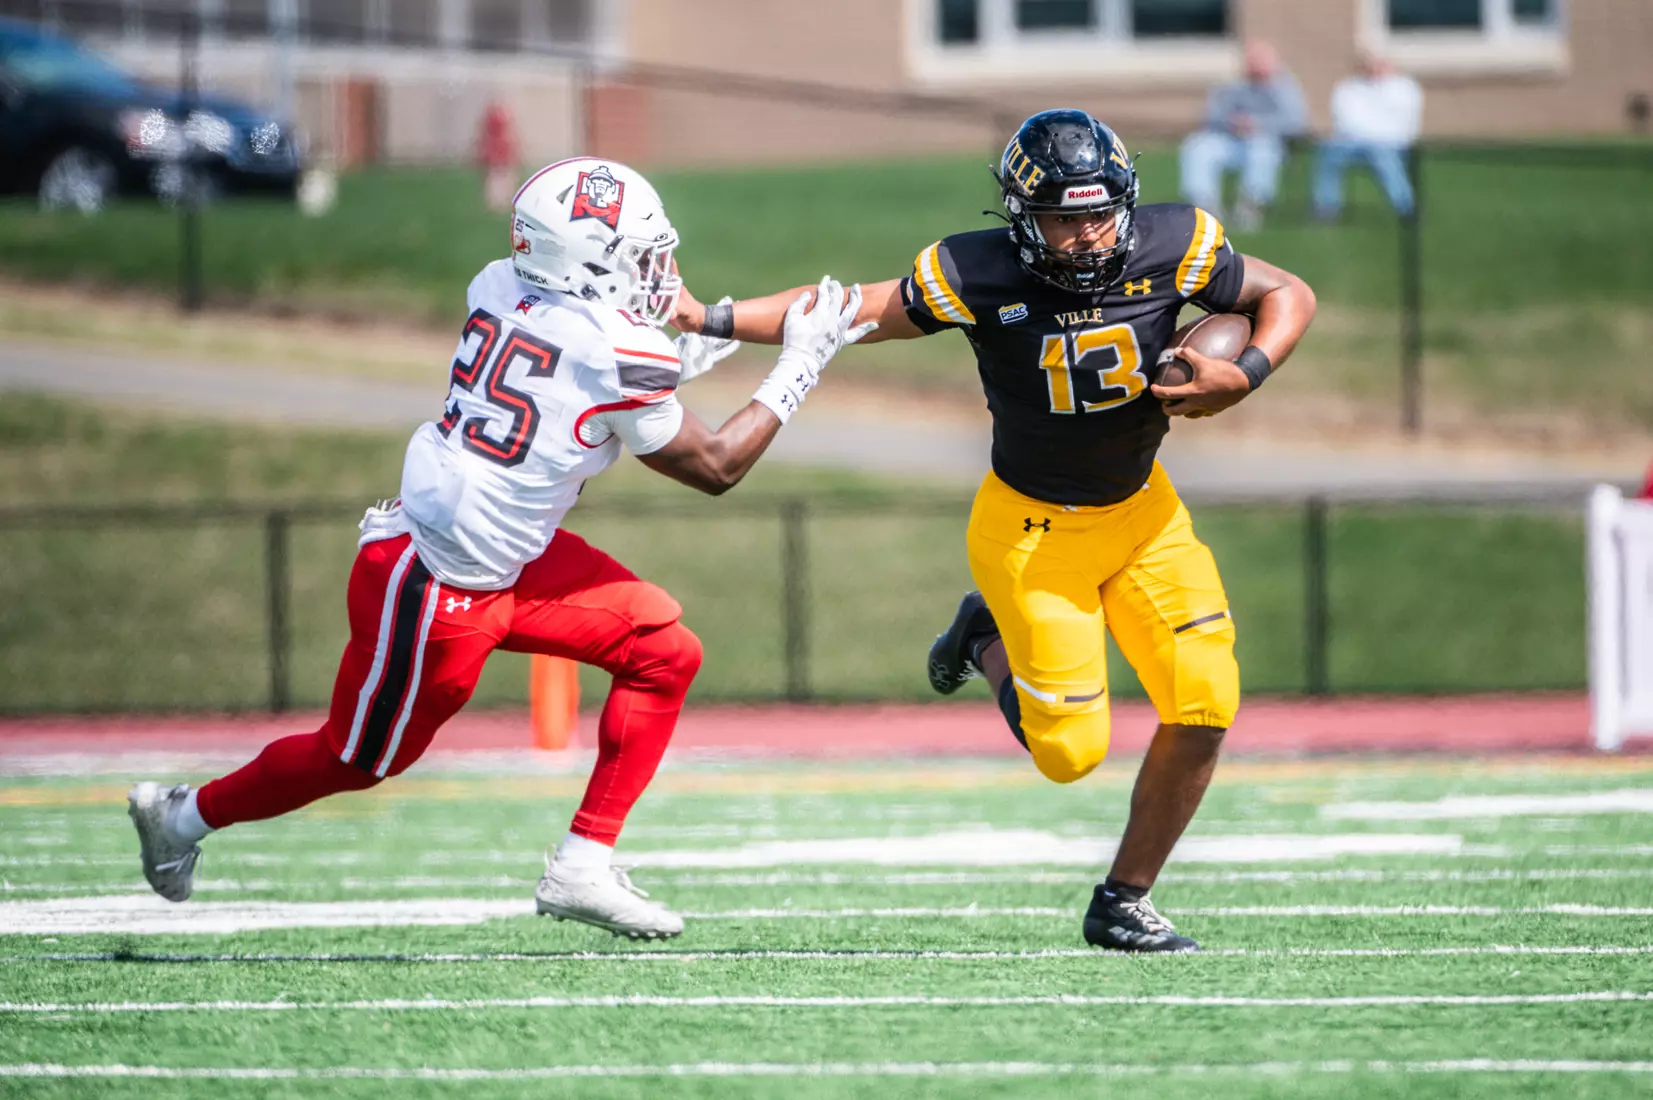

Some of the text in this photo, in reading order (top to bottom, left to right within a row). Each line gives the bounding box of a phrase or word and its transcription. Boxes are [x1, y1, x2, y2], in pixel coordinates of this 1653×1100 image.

[1068, 188, 1103, 200] Riddell
[521, 270, 549, 286] THICK
[1000, 306, 1027, 320] PSAC
[1054, 307, 1104, 328] VILLE
[1038, 322, 1149, 415] 13
[436, 307, 564, 468] 25
